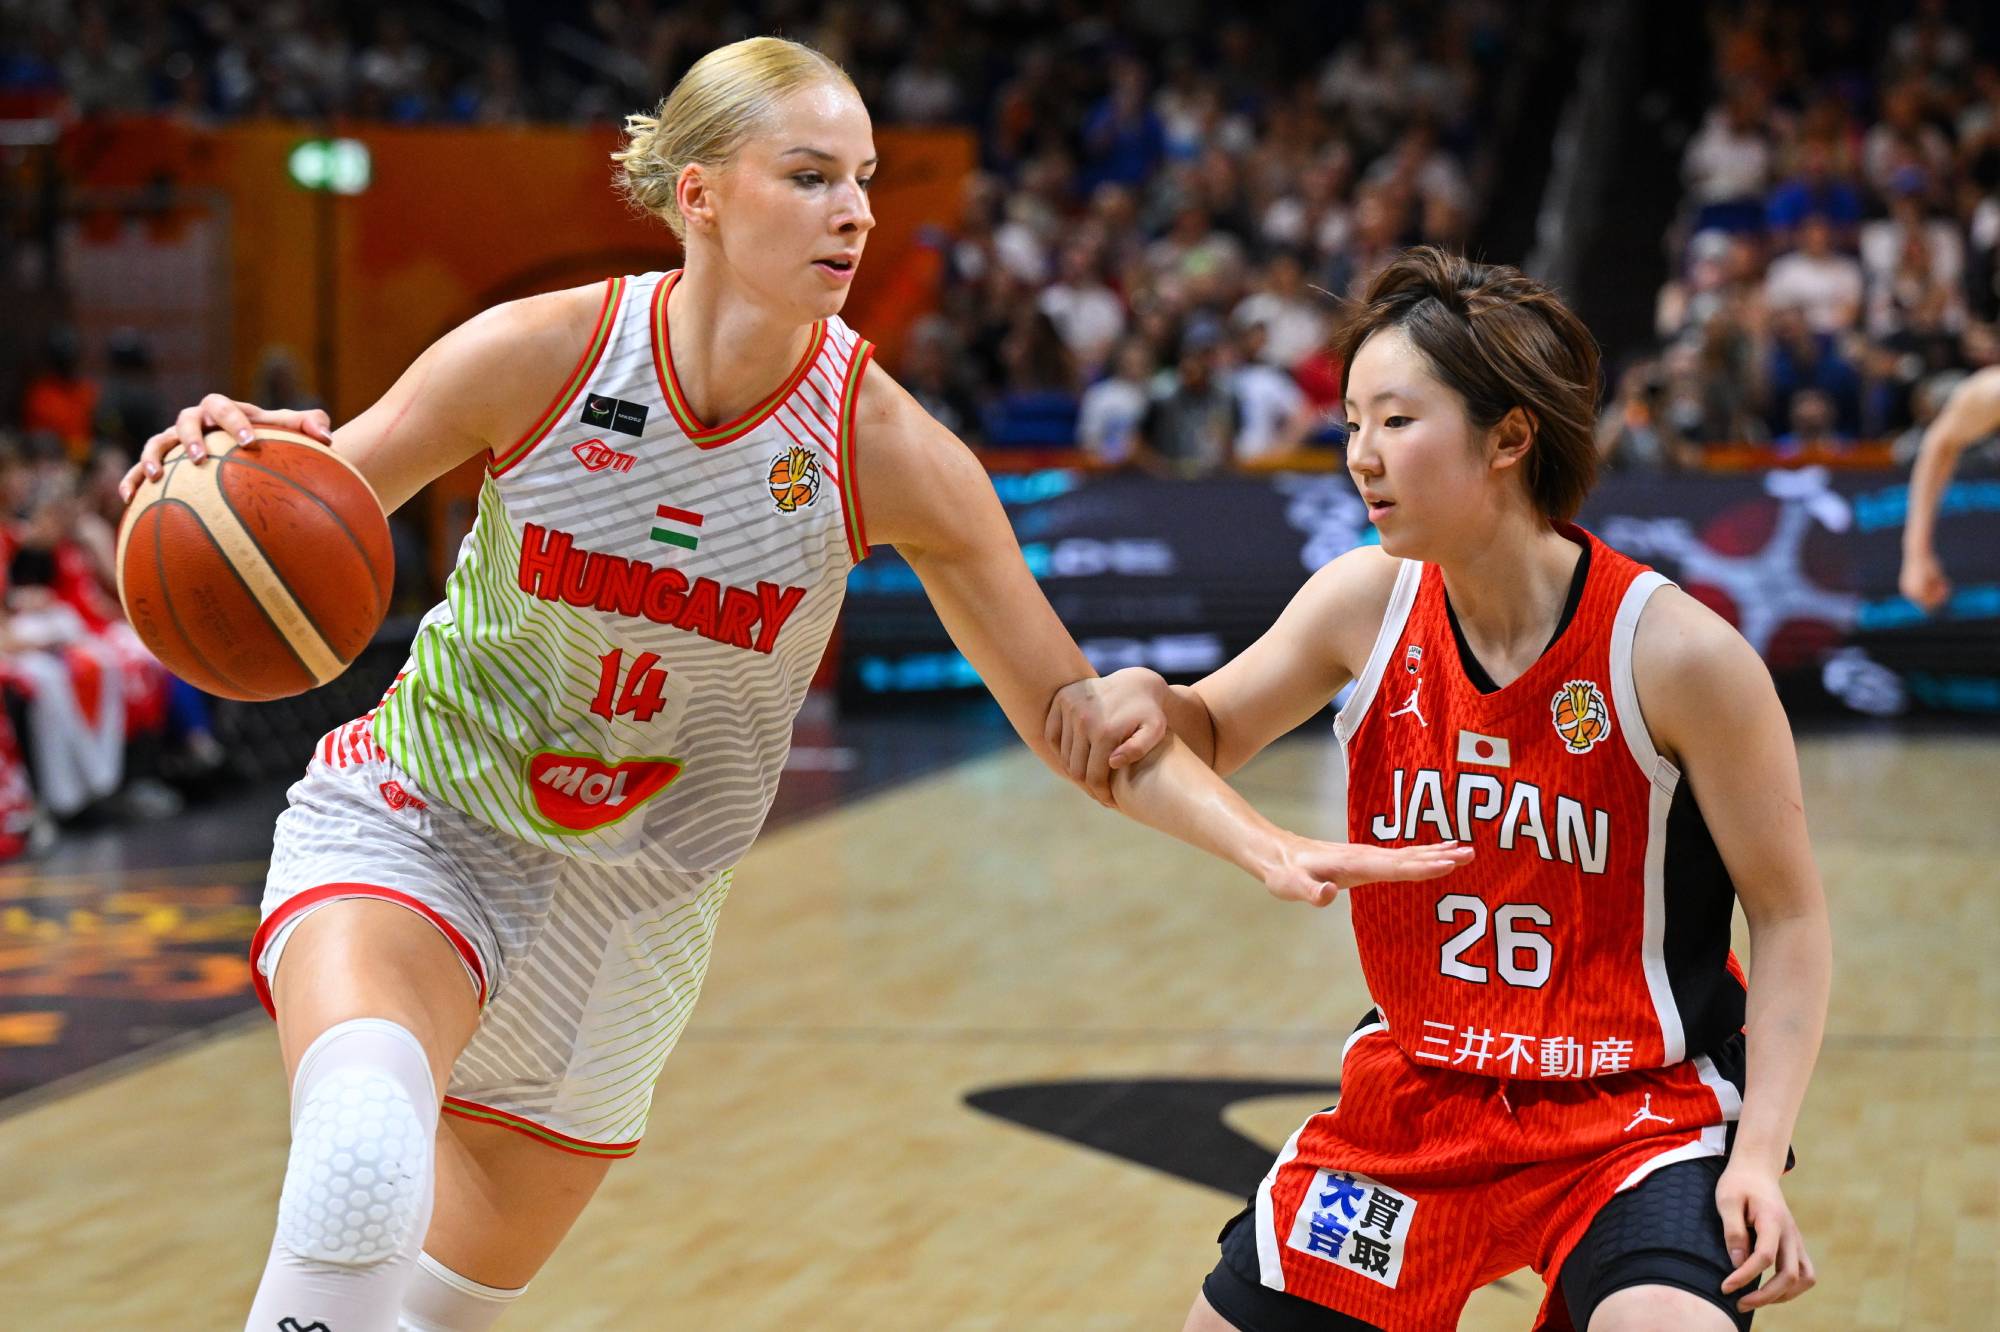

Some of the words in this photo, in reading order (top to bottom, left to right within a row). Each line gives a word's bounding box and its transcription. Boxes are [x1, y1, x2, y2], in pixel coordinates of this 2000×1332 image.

[584, 444, 639, 473] TOTI
[518, 522, 806, 655] HUNGARY
[590, 648, 668, 723] 14
[539, 765, 628, 806] MOL
[1372, 769, 1608, 874] JAPAN
[1435, 893, 1553, 988] 26
[1415, 1020, 1633, 1078] 三井不動産
[1349, 1187, 1404, 1278] 買取
